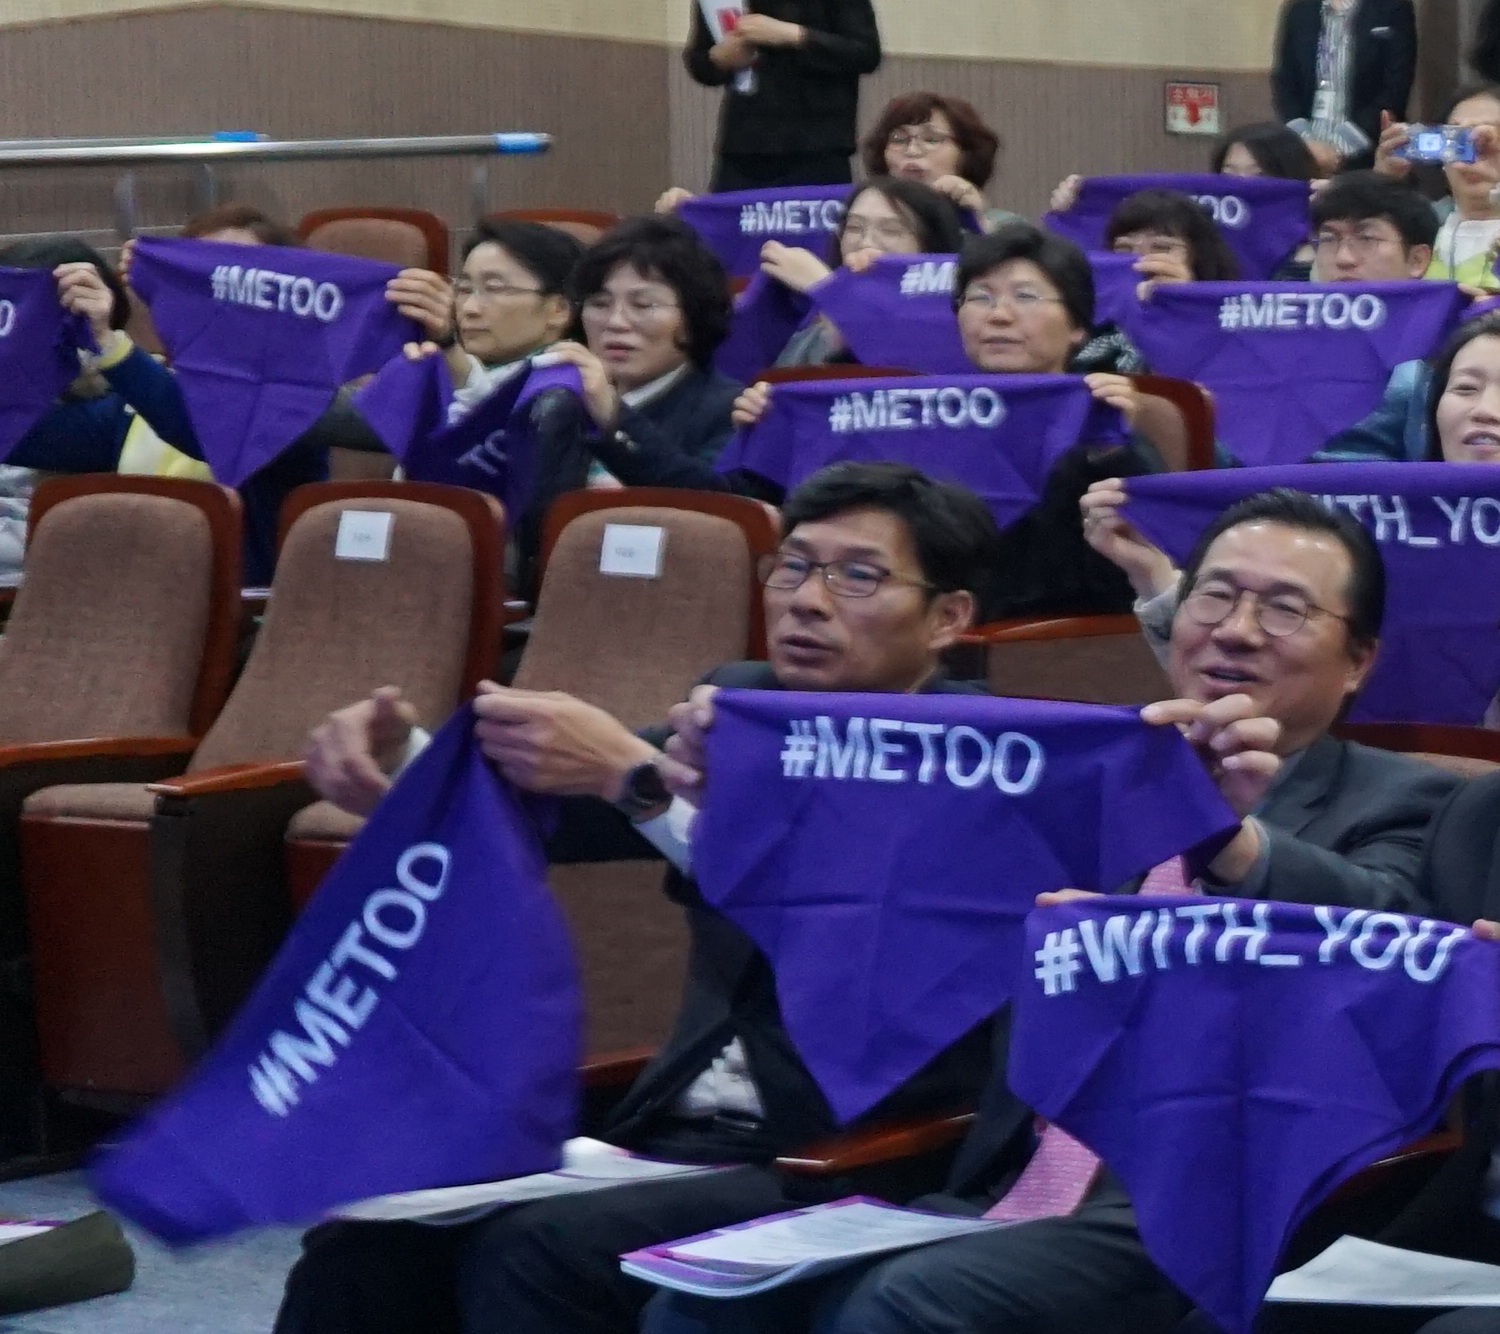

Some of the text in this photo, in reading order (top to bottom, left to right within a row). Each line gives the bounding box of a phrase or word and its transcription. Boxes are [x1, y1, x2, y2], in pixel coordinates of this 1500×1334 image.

[741, 201, 842, 231] #METO
[212, 265, 342, 320] #METOO
[1219, 294, 1381, 327] #METOO
[829, 387, 1001, 431] #METOO
[781, 716, 1042, 793] #METOO
[1035, 903, 1469, 994] #WITH_YOU
[251, 844, 449, 1116] #METOO
